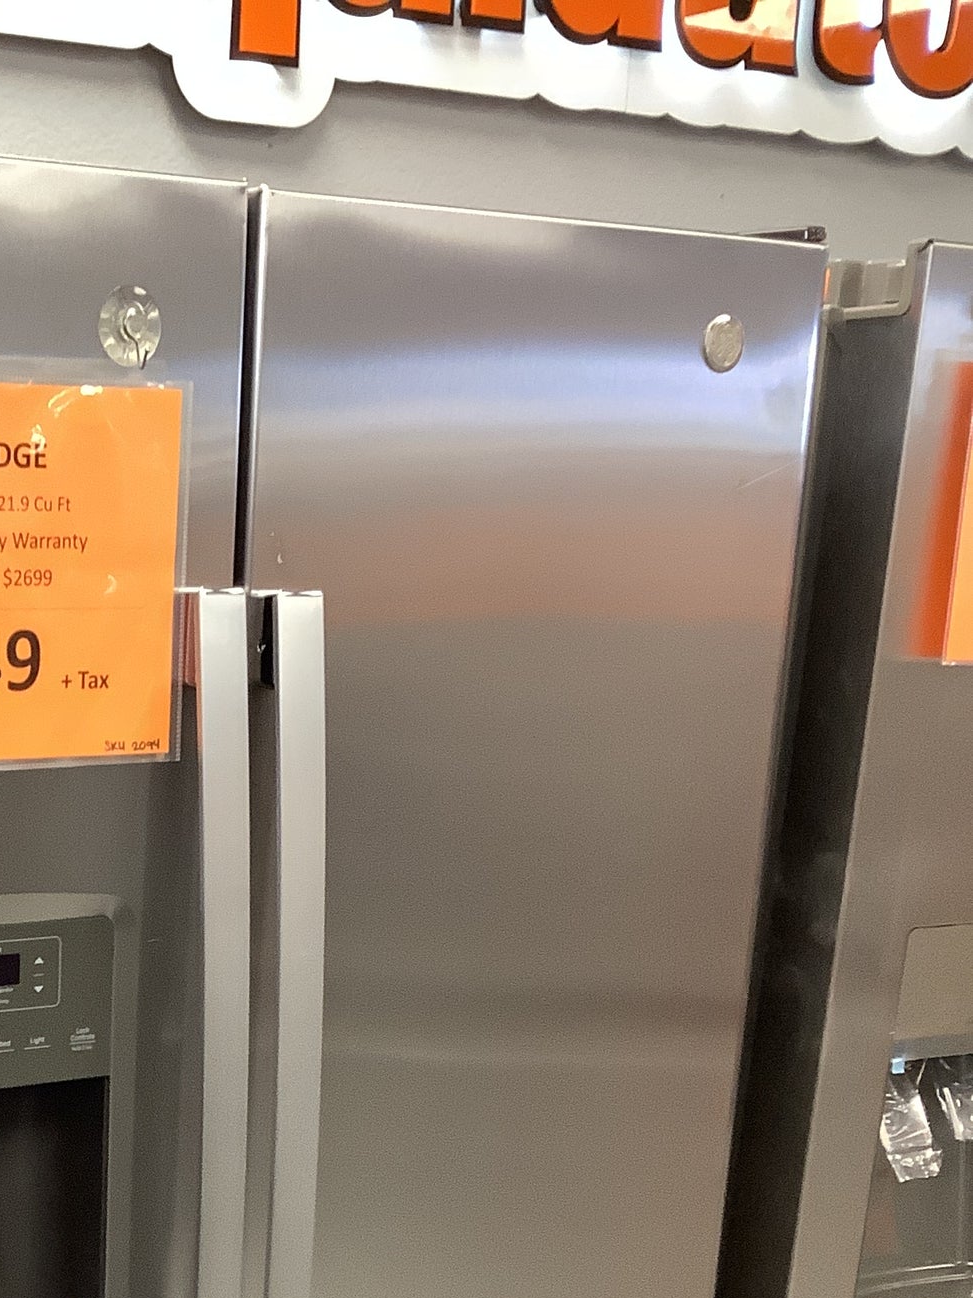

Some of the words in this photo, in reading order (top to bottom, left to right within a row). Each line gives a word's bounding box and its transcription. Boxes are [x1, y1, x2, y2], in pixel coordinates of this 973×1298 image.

[34, 496, 53, 512] Cu
[57, 496, 71, 512] Ft
[12, 532, 89, 554] Warranty
[2, 567, 53, 588] $2699
[78, 671, 109, 690] Tax
[104, 740, 125, 752] SKU
[132, 738, 160, 751] 2094
